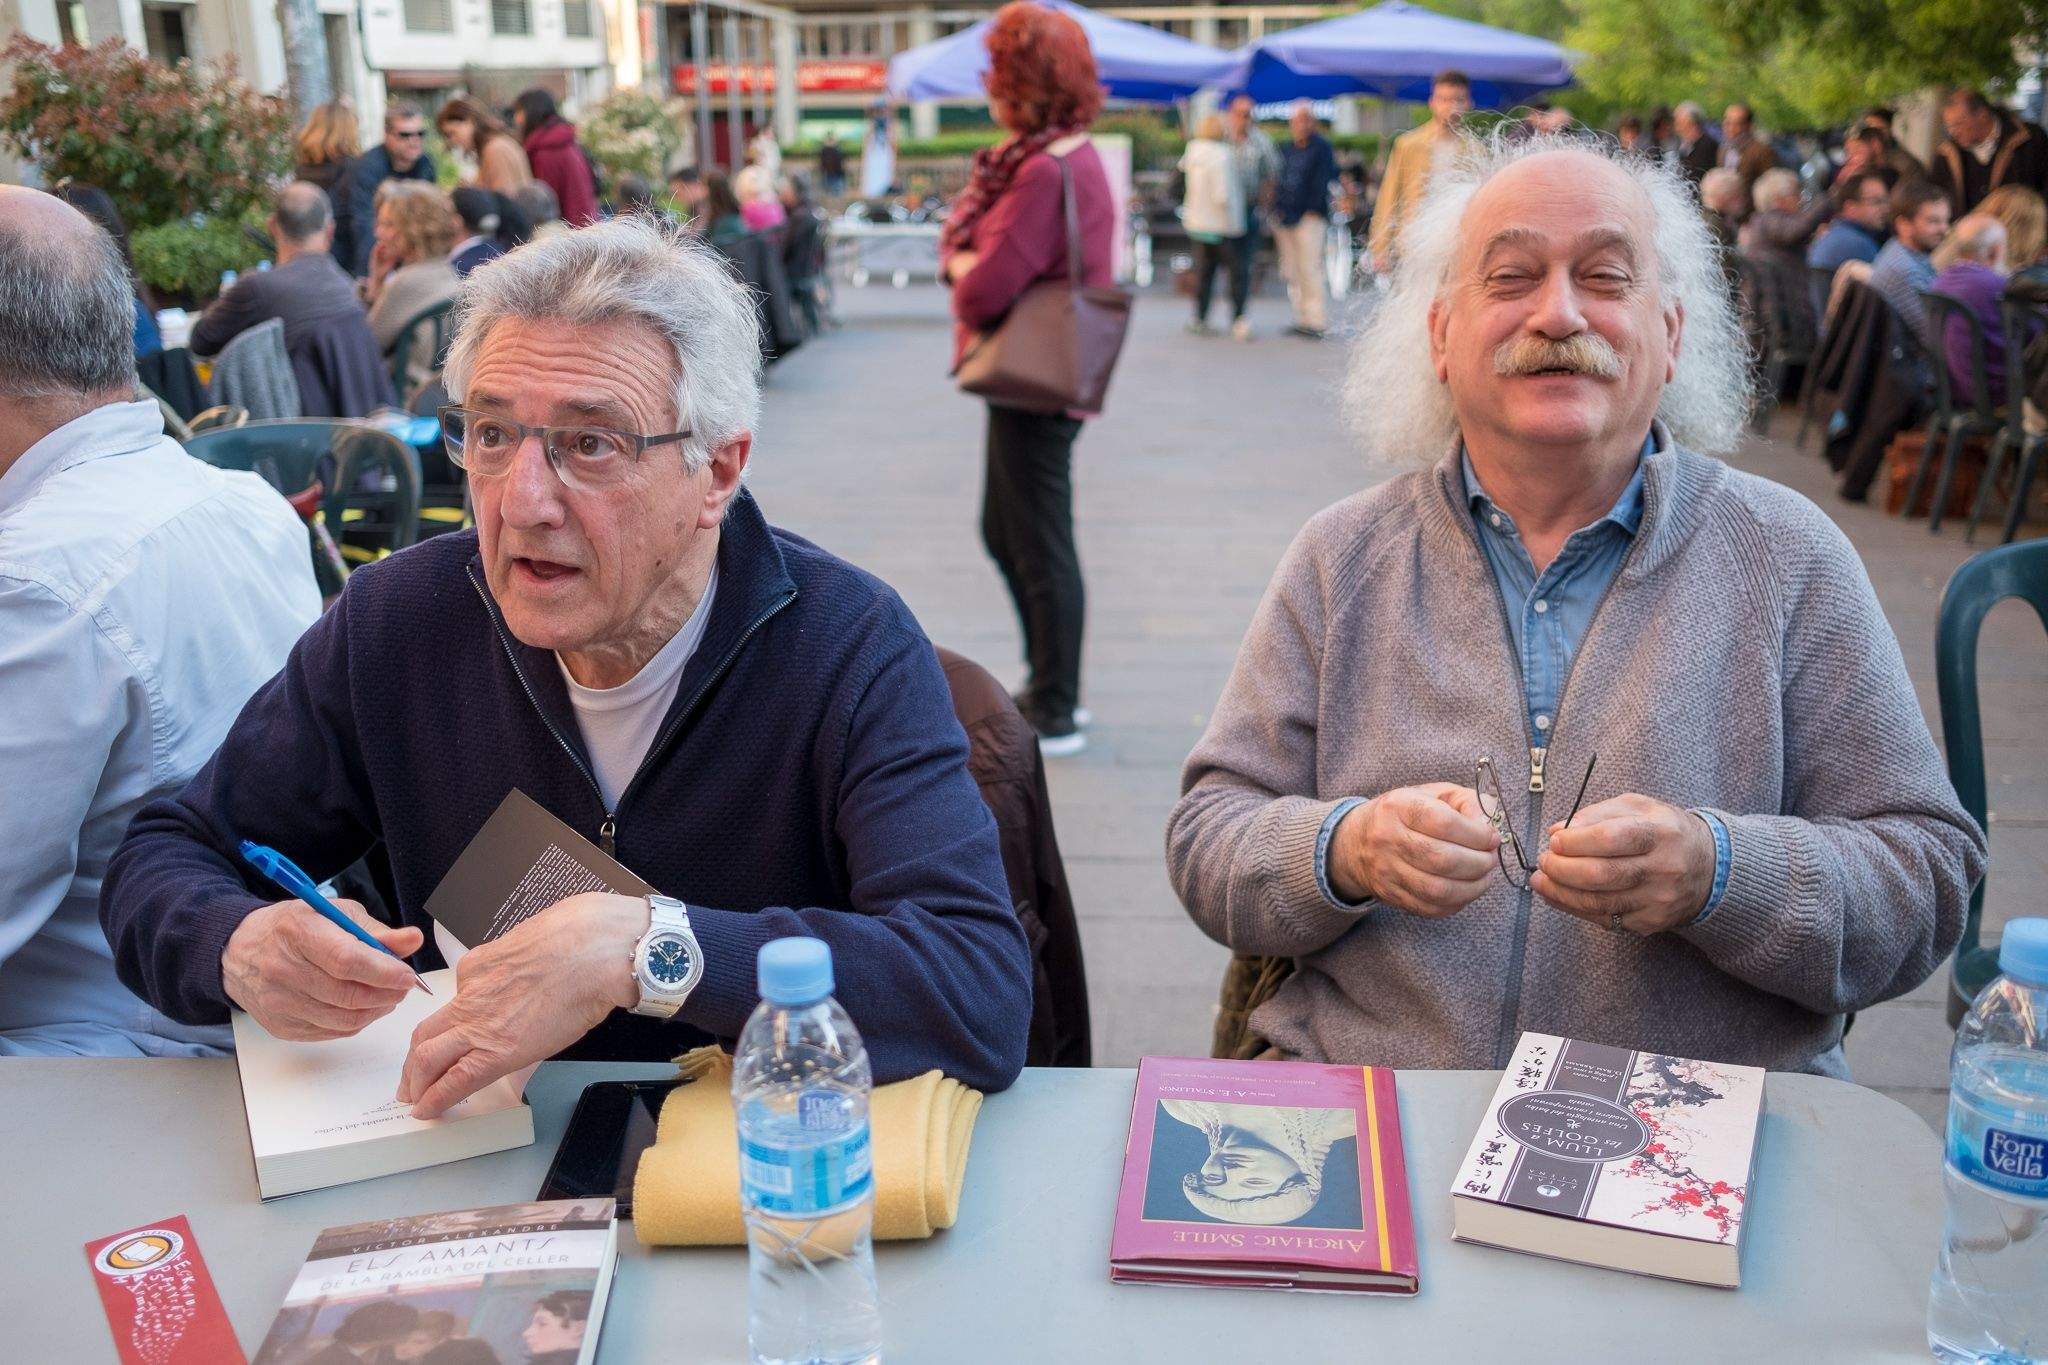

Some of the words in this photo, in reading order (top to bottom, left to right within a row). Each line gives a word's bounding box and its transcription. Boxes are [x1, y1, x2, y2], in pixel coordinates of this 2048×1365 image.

[1159, 1086, 1216, 1096] STALLINGS
[1524, 1104, 1550, 1114] haiku
[1529, 1098, 1588, 1113] contemporani
[1566, 1112, 1607, 1124] antologia
[1595, 1111, 1629, 1122] modern
[1520, 1122, 1599, 1145] GOLFES
[1609, 1121, 1628, 1130] Una
[1547, 1137, 1603, 1157] LLUM
[1603, 1139, 1624, 1149] les
[1990, 1132, 2044, 1159] Font
[1989, 1149, 2043, 1177] Vella
[441, 1223, 558, 1241] ALEXANDRE
[1172, 1231, 1246, 1248] SMILE
[1254, 1235, 1367, 1253] ARCHAIC
[346, 1252, 404, 1273] ELS
[418, 1237, 556, 1263] AMANTS
[319, 1279, 342, 1291] DE
[349, 1275, 371, 1287] LA
[380, 1264, 456, 1282] RAMBLA
[463, 1259, 495, 1271] DEL
[505, 1254, 570, 1267] CELLER
